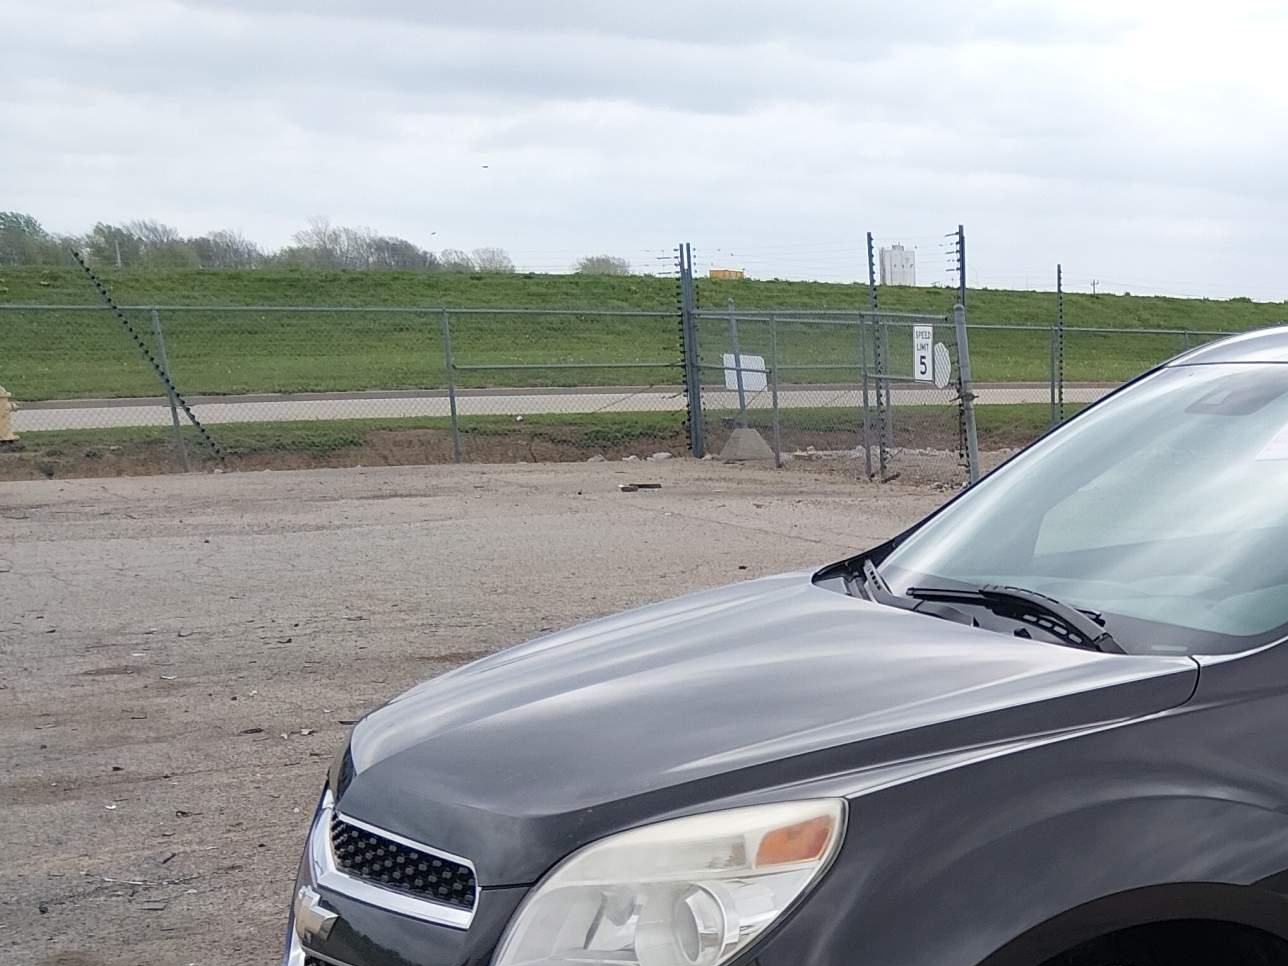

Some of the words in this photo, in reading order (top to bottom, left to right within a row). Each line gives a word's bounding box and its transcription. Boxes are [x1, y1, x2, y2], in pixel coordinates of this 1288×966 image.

[915, 330, 932, 340] SPEED
[916, 343, 929, 352] LIMIT
[919, 355, 928, 375] 5
